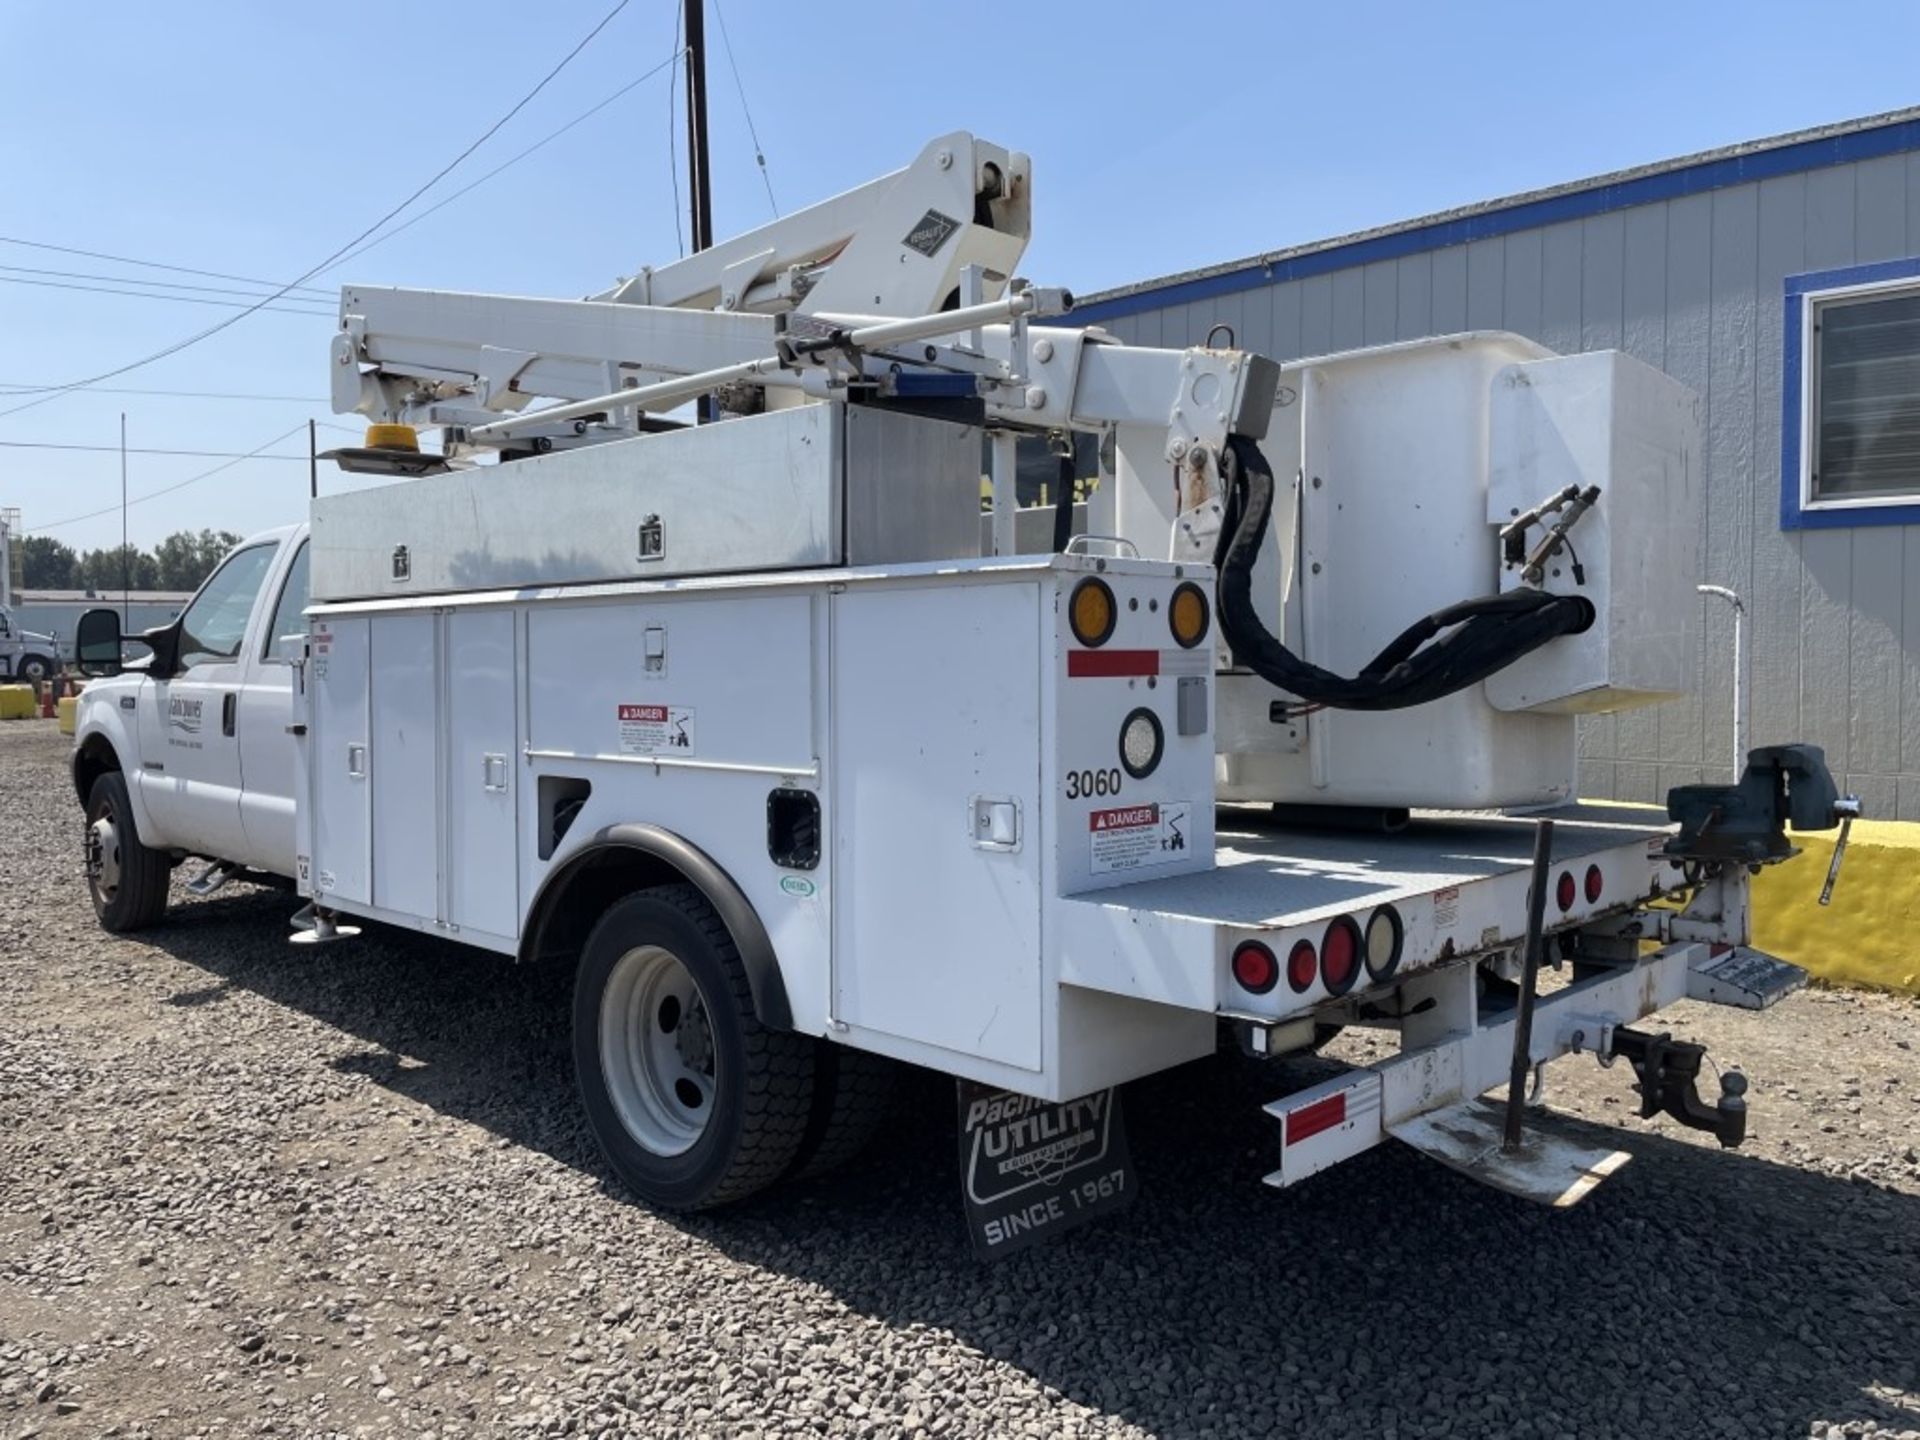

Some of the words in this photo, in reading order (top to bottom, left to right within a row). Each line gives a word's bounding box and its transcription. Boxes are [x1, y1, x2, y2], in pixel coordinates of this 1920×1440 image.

[630, 708, 663, 719] DANGER
[1066, 767, 1122, 799] 3060
[1108, 809, 1152, 827] DANGER
[984, 1090, 1105, 1158] UTILITY
[984, 1195, 1065, 1246] SINCE
[1069, 1169, 1125, 1209] 1967
